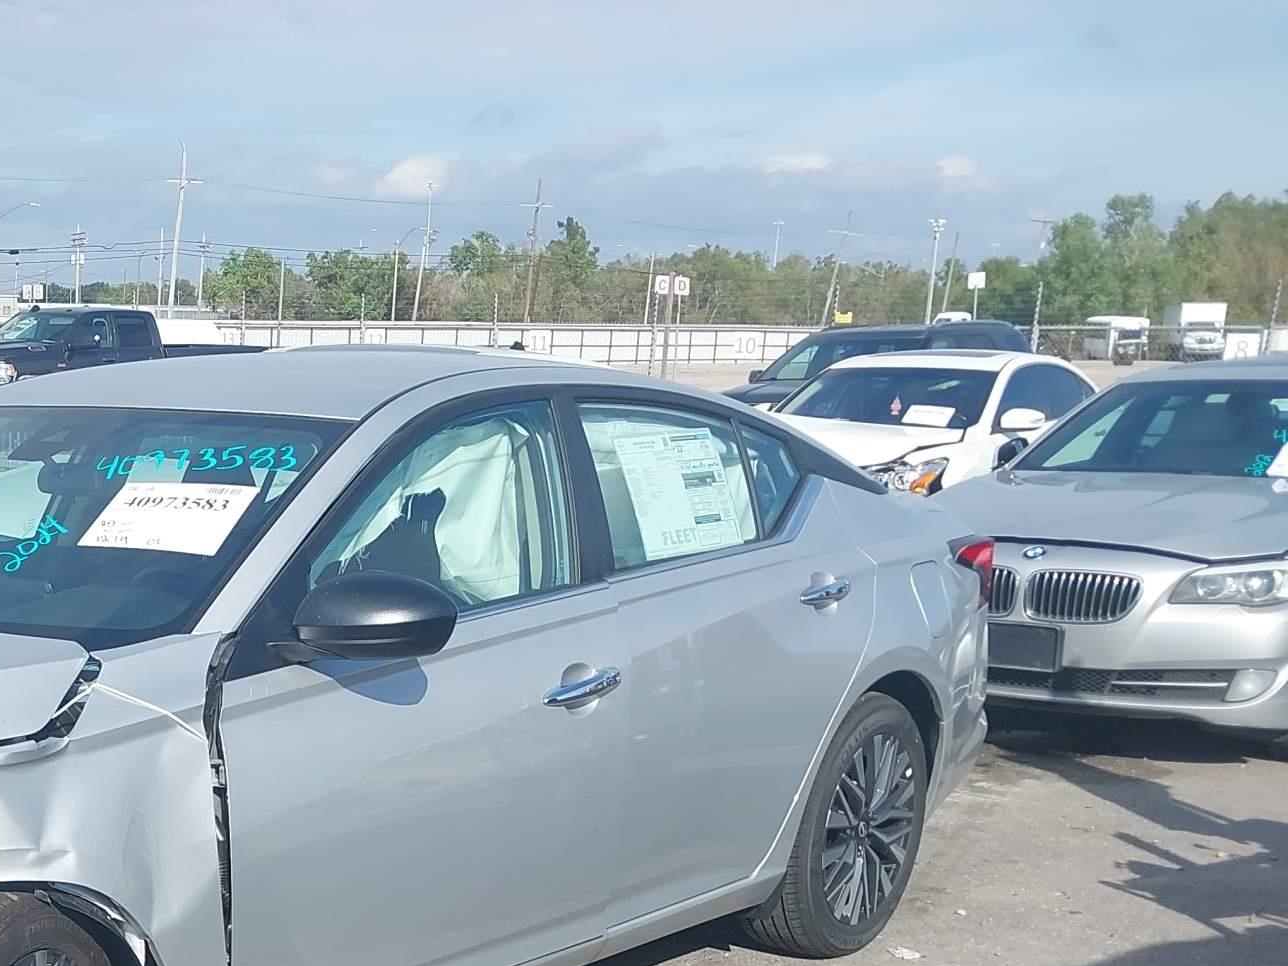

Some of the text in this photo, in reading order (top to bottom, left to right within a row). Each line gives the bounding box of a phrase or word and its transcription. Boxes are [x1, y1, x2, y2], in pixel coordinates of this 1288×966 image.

[658, 279, 667, 291] C
[678, 279, 686, 291] D
[530, 335, 547, 351] 11
[735, 337, 756, 354] 10
[96, 443, 298, 481] 40973583
[123, 495, 230, 512] 40973583
[661, 527, 697, 546] FLEET
